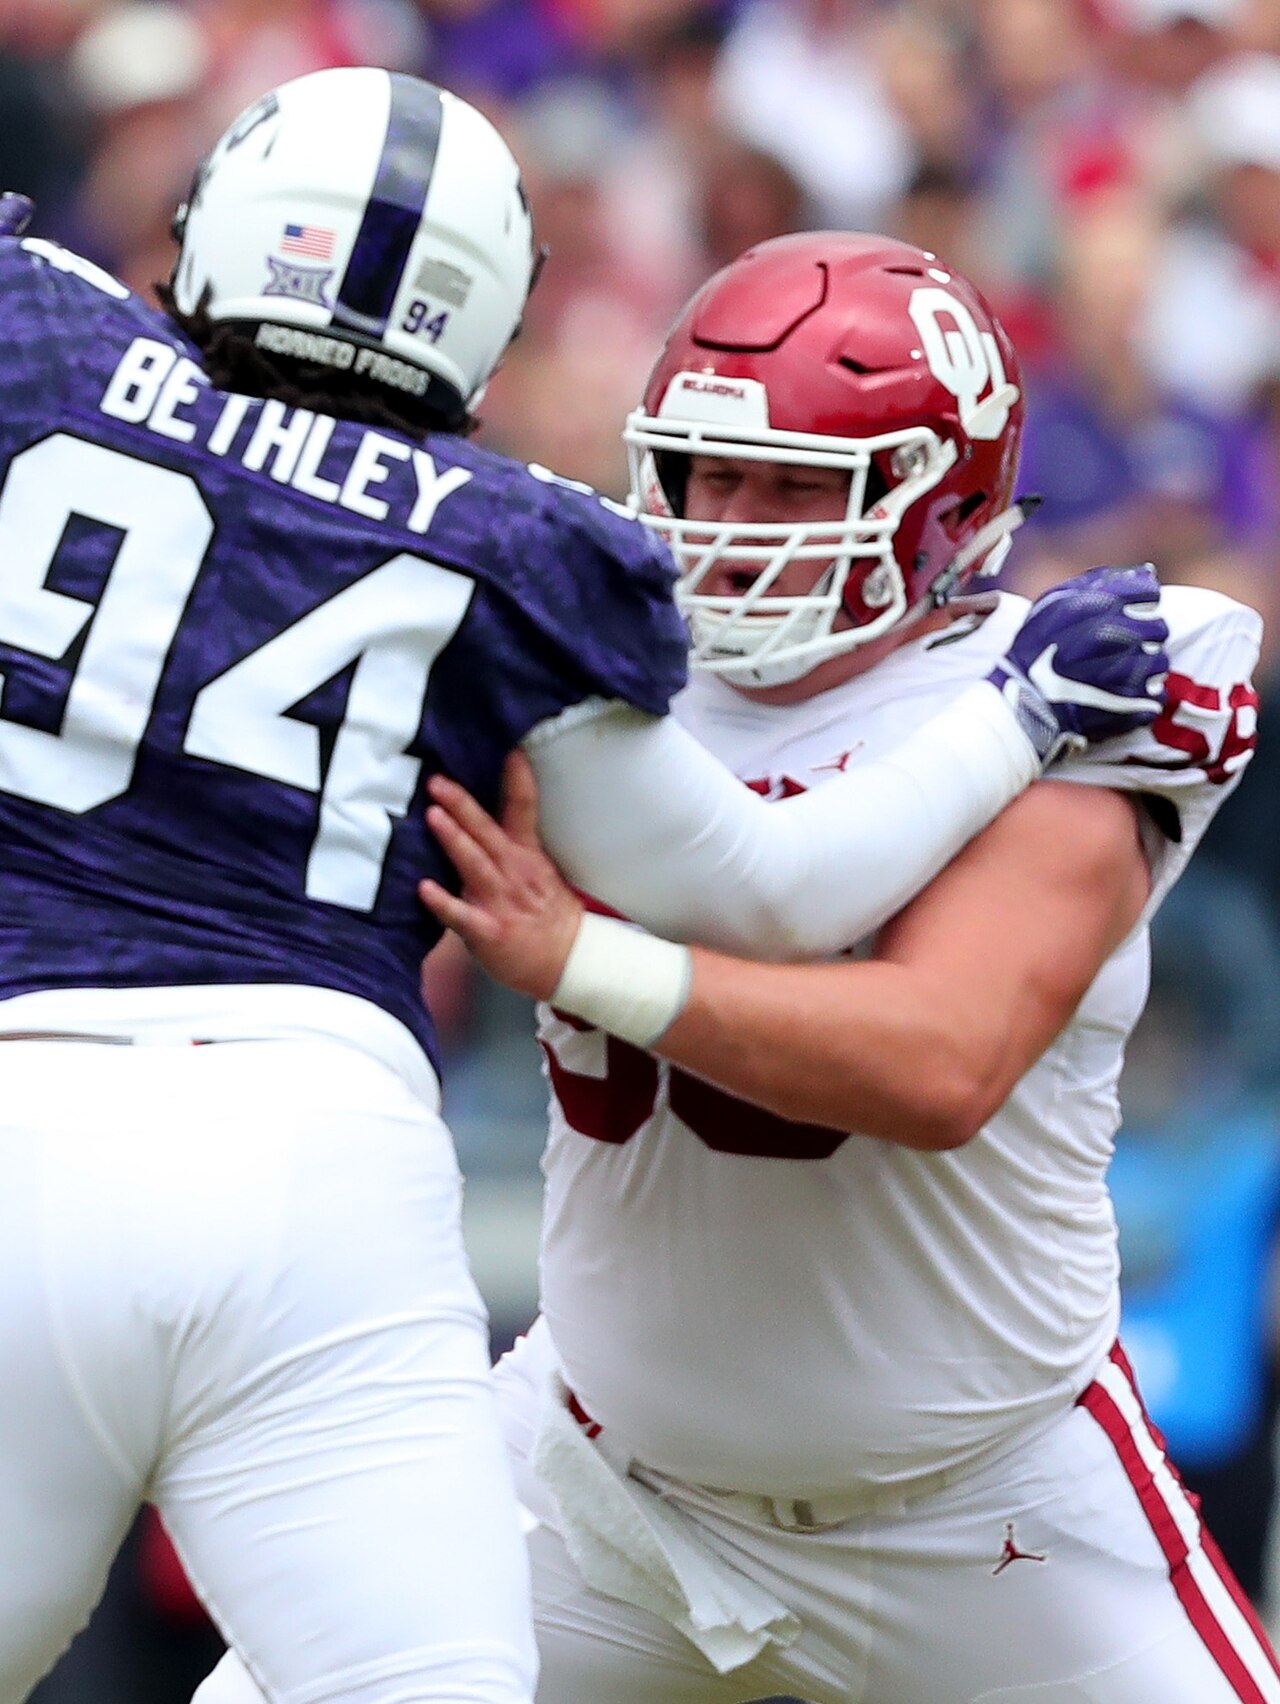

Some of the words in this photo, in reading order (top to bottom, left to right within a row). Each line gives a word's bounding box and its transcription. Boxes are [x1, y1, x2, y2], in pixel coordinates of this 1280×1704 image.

[255, 322, 356, 371] HORNED
[353, 348, 431, 397] FROGS
[402, 300, 448, 344] 94
[100, 337, 472, 534] BETHLEY
